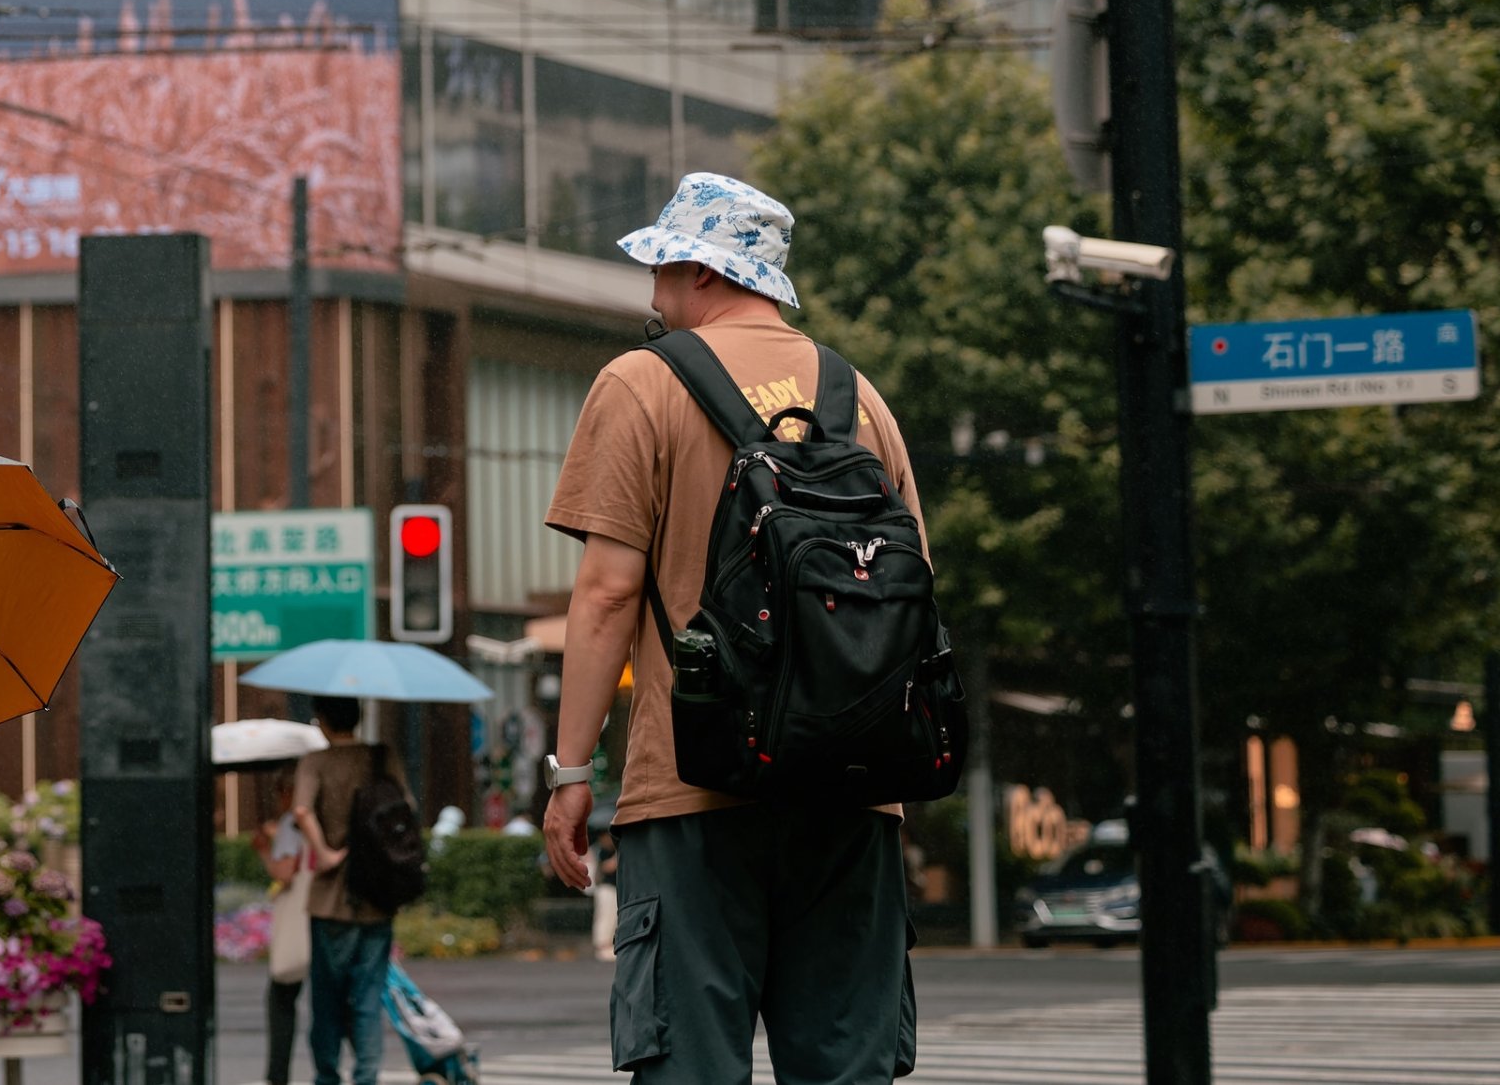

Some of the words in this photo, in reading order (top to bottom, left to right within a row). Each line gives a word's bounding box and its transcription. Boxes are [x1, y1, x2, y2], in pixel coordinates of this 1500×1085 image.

[1262, 329, 1405, 369] 石门一路
[1442, 375, 1459, 394] S
[1213, 388, 1230, 403] N
